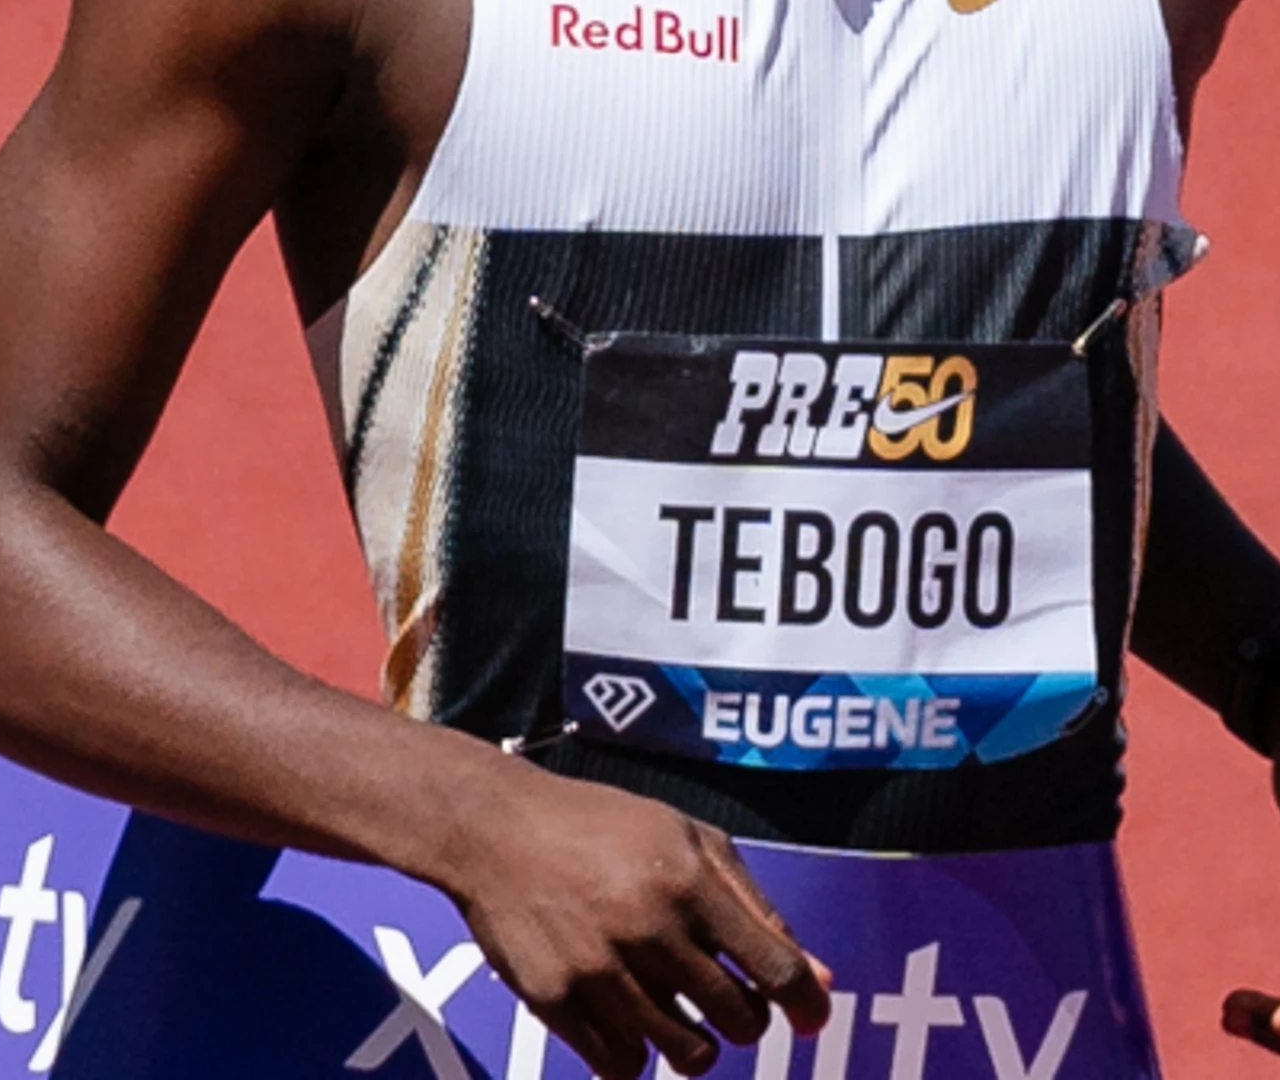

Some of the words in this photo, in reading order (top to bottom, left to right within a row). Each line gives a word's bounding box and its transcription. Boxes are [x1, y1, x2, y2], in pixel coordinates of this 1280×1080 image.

[551, 4, 643, 50] Red
[654, 10, 738, 63] Bull
[659, 506, 1014, 629] TEBOGO
[702, 691, 961, 749] EUGENE
